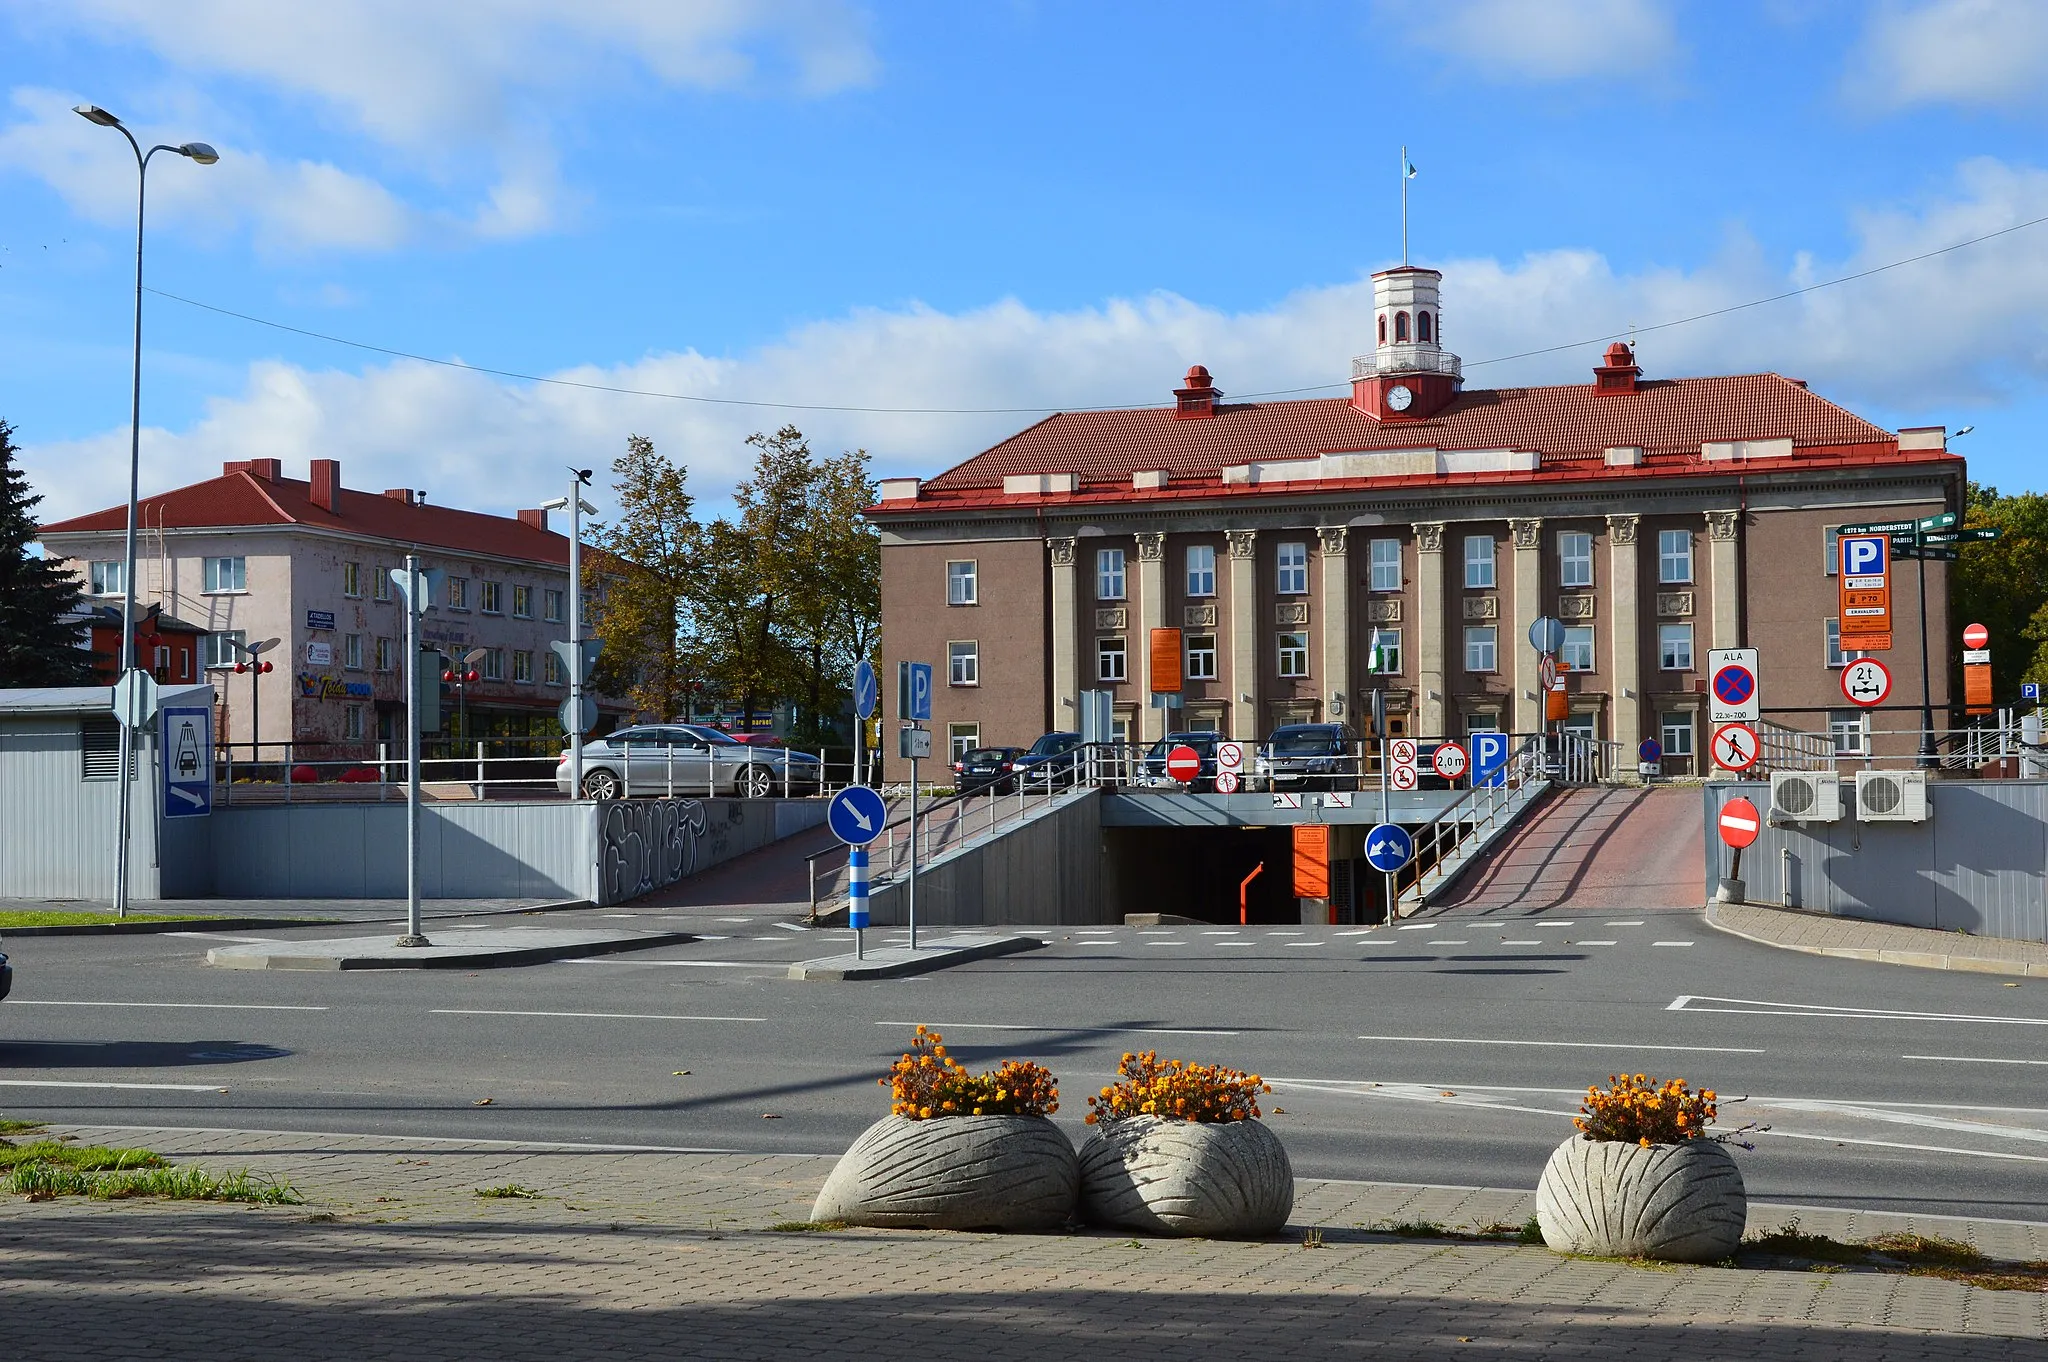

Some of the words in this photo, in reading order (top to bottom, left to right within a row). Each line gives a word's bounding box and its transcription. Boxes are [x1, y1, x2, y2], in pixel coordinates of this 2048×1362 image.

[1869, 523, 1912, 532] NORDERSTEDT
[1851, 541, 1877, 572] P
[1723, 652, 1743, 661] ALA
[916, 669, 927, 713] P
[2025, 685, 2034, 696] P
[1480, 738, 1499, 766] P
[1437, 757, 1453, 768] 2,0
[1455, 758, 1465, 766] m
